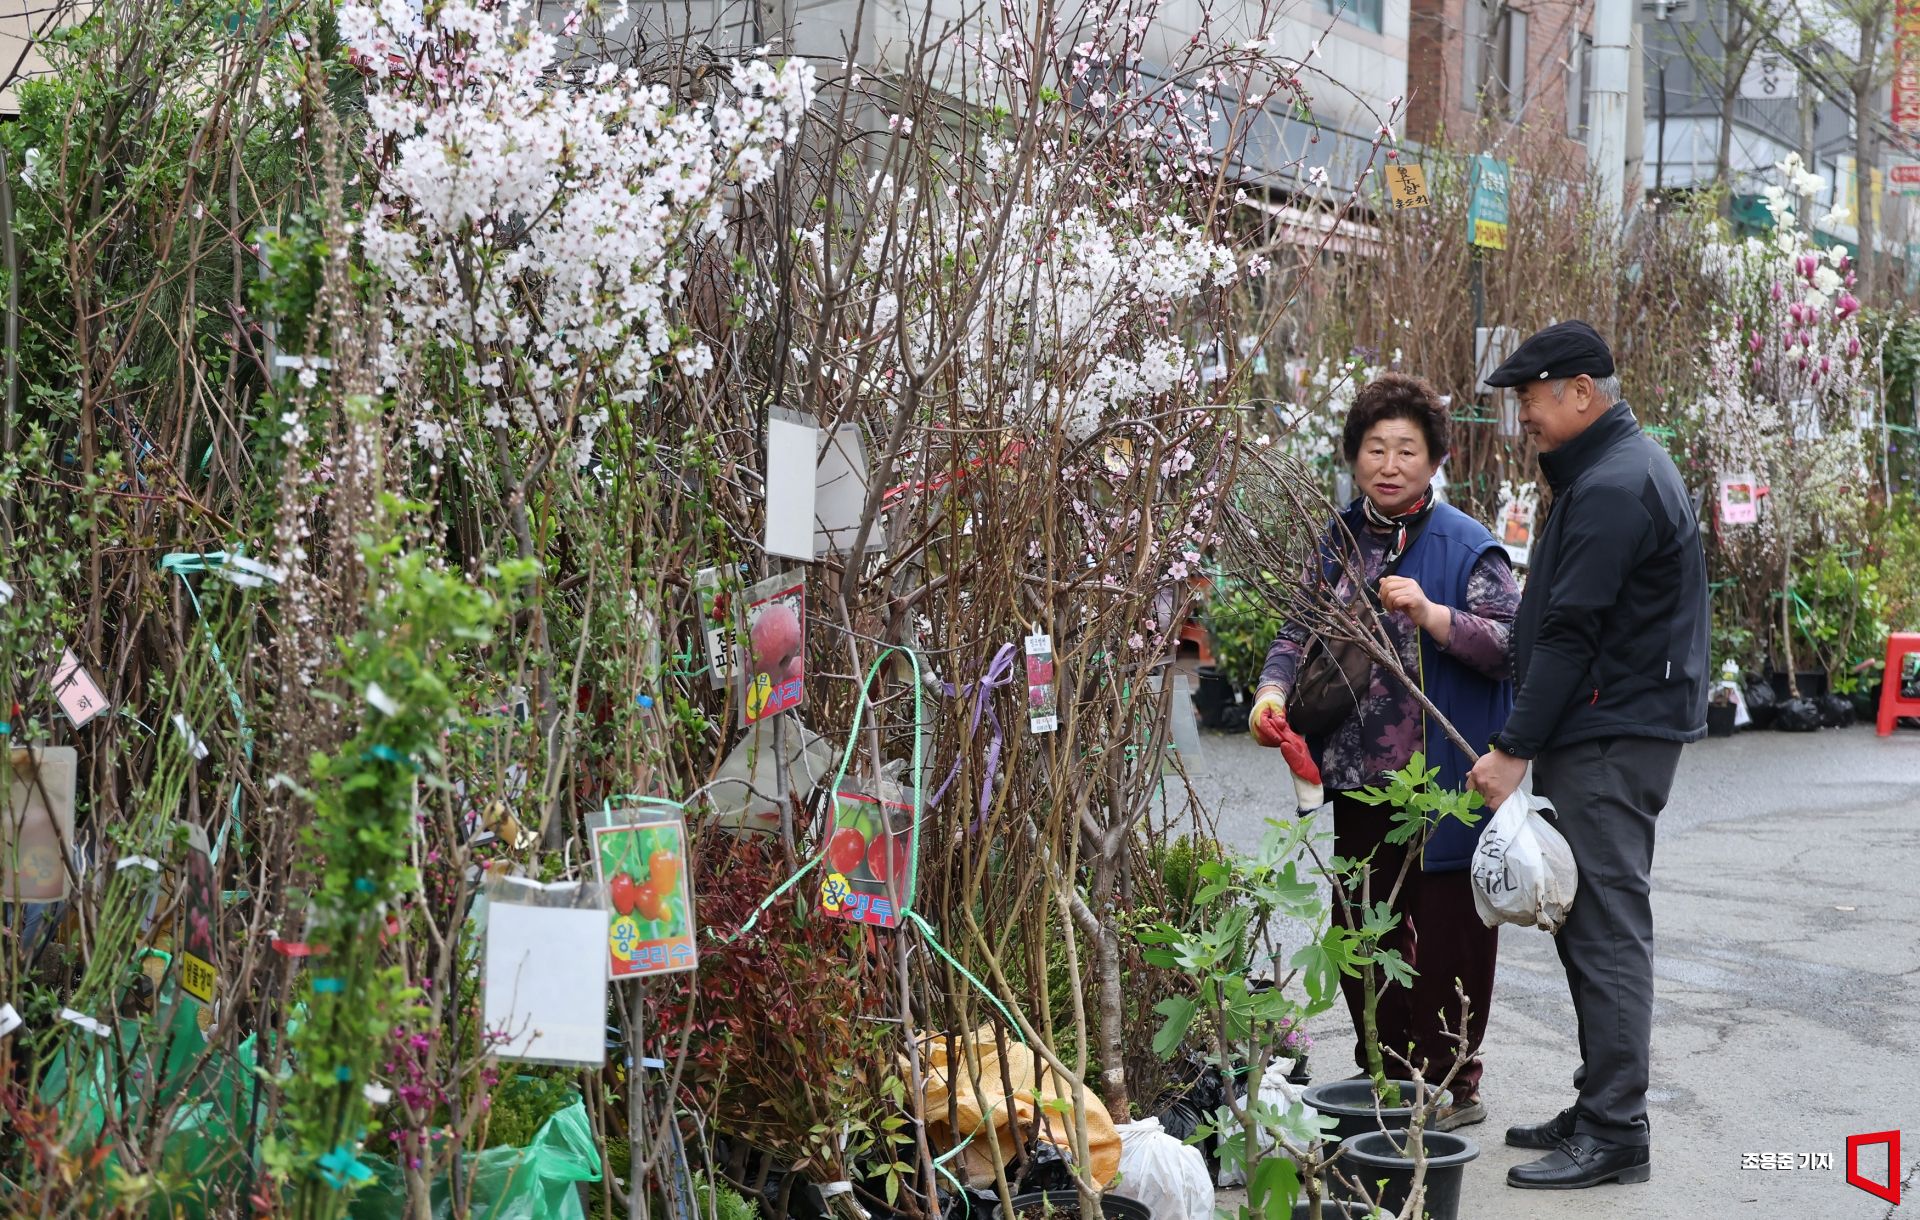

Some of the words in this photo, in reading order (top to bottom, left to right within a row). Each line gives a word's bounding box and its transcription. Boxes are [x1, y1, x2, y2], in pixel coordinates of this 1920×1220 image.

[767, 677, 802, 709] 사과
[824, 880, 846, 905] 왕
[844, 893, 893, 925] 앵두
[613, 923, 636, 952] 왕
[629, 943, 693, 970] 보리수
